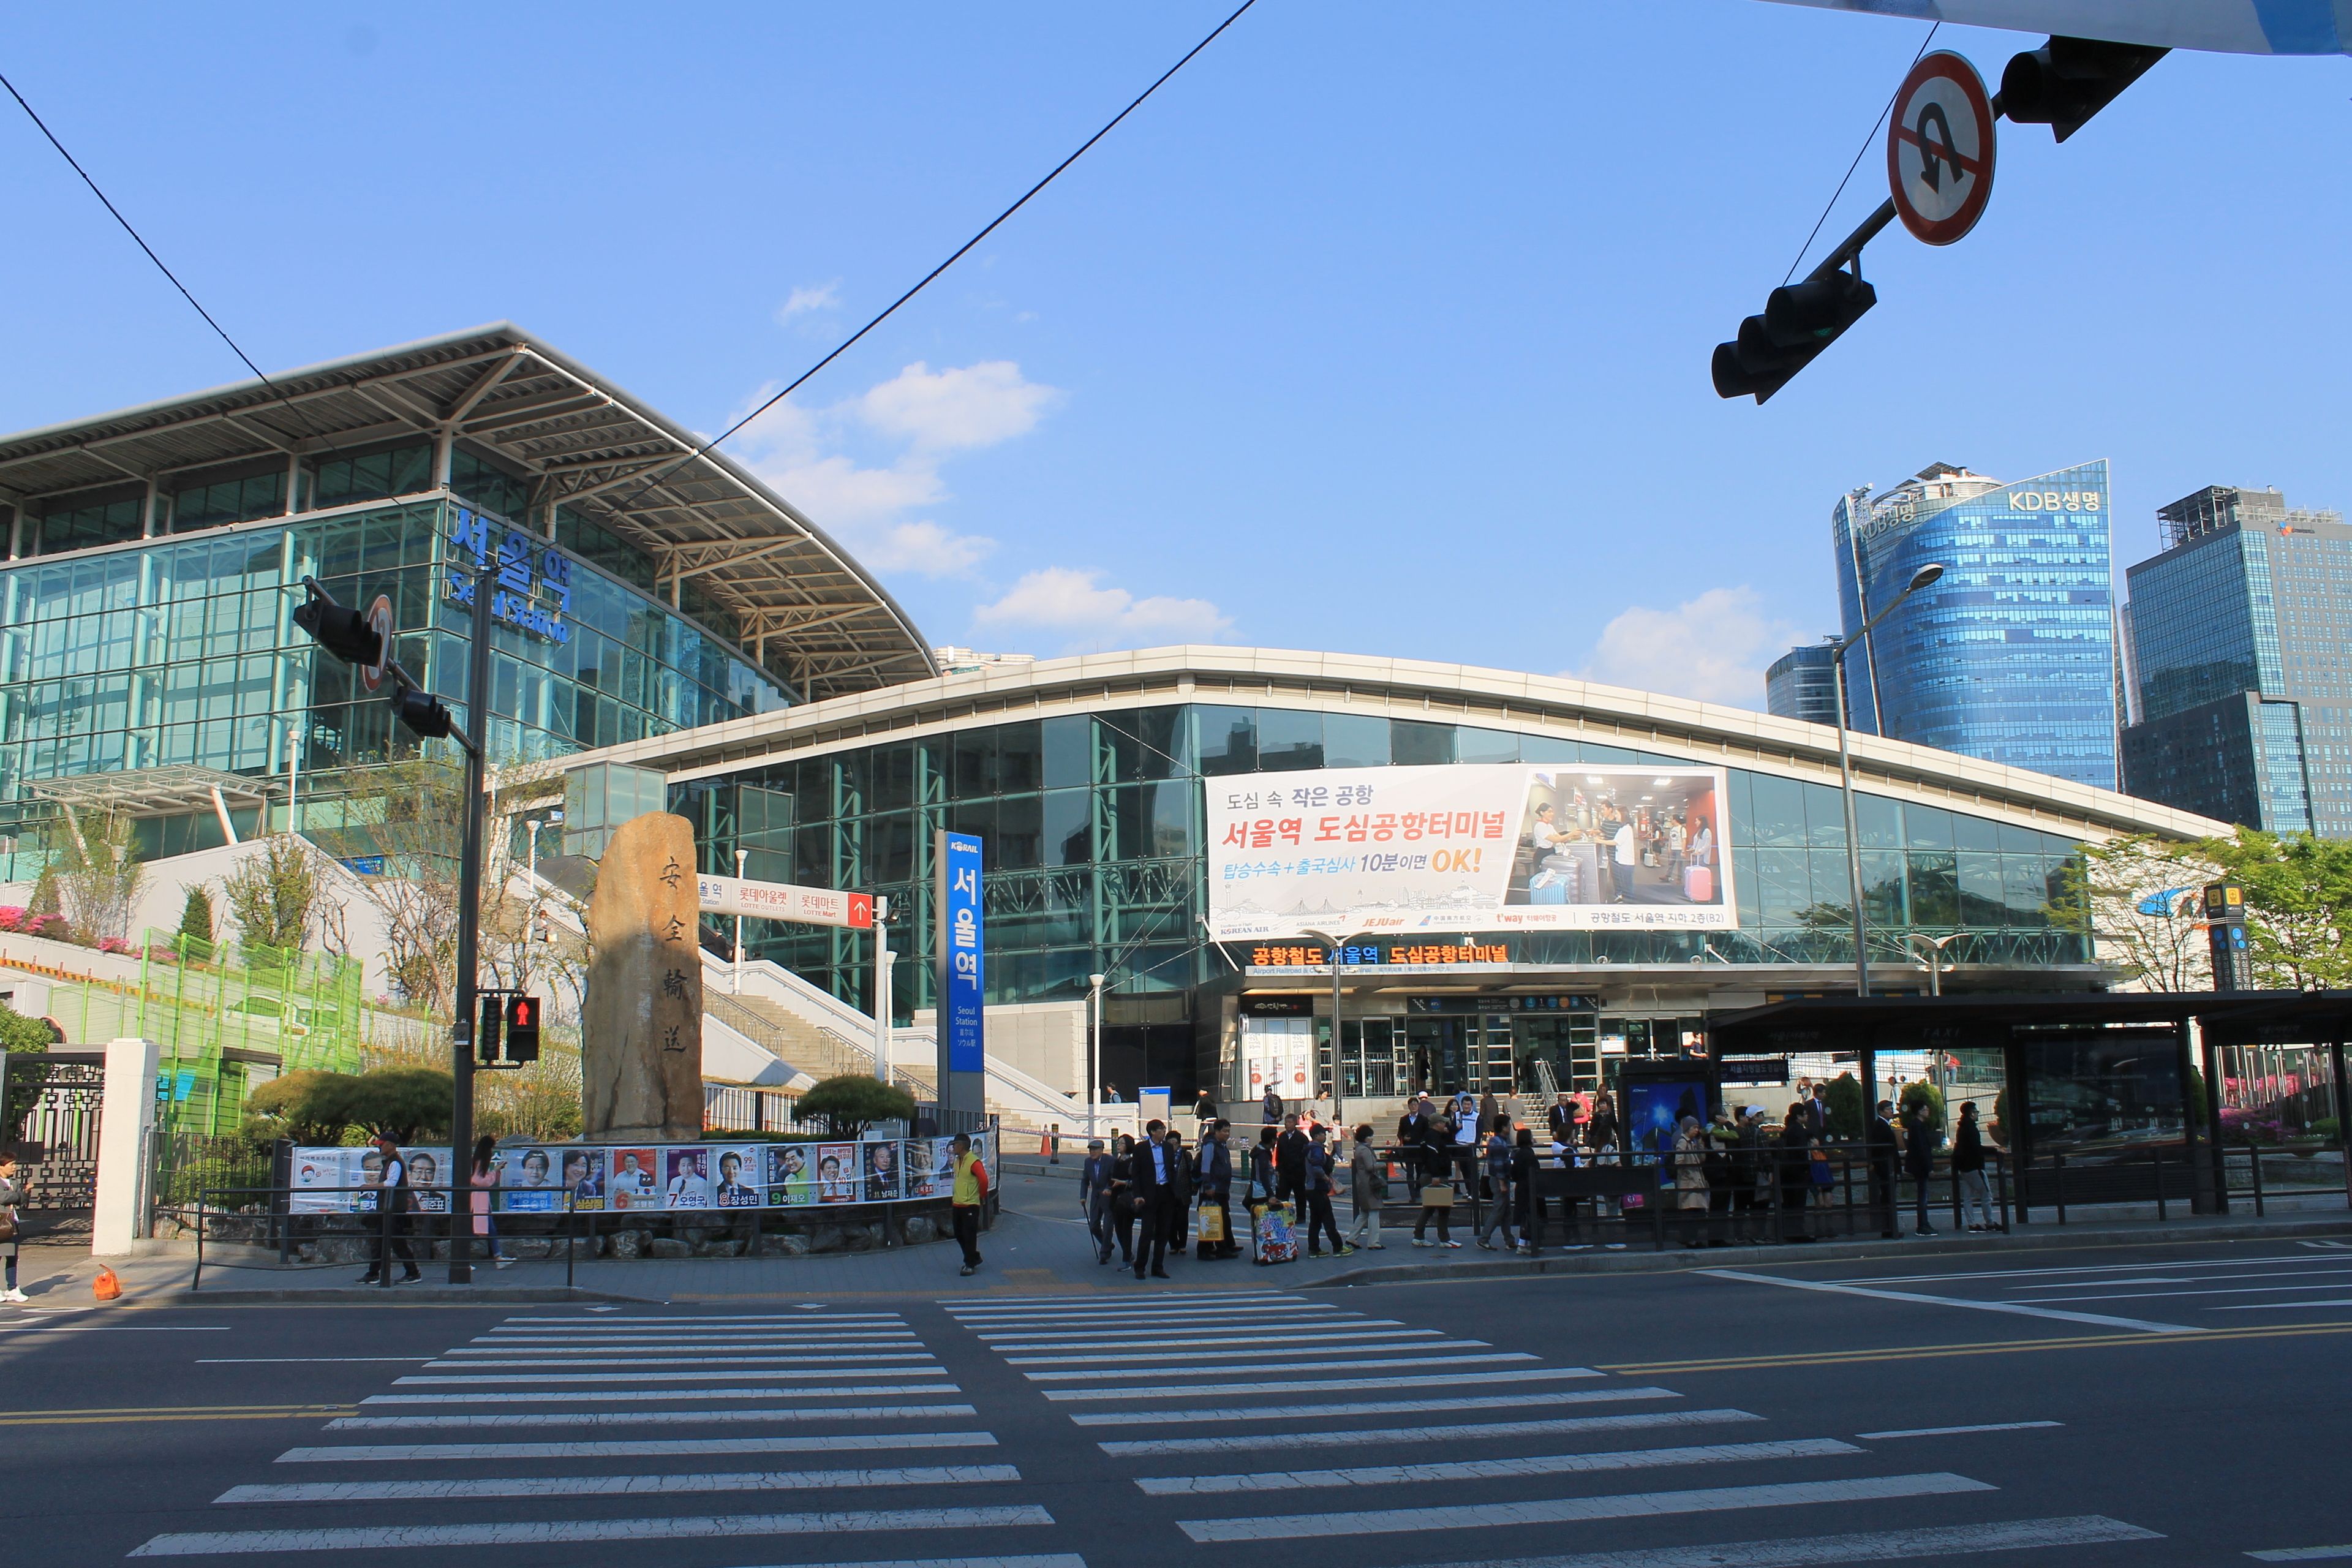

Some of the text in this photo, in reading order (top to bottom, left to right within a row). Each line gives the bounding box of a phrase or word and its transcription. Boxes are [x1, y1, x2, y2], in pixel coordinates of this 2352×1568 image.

[2008, 491, 2099, 511] KDB생명
[451, 508, 571, 614] 서울역
[507, 596, 569, 644] Station
[1227, 784, 1373, 810] 도심 속 작은 공항
[1222, 810, 1506, 849] 서울역 도심공항터미널
[951, 841, 979, 854] KORAIL
[1361, 853, 1428, 873] 10분이면
[1432, 847, 1482, 873] OK!
[702, 897, 720, 905] Station
[739, 887, 787, 905] 롯데아울렛
[801, 894, 840, 910] 롯데마트
[1590, 912, 1725, 924] 공항철도 서울역 지하 2층(B2)
[953, 866, 978, 992] 서울역
[1220, 927, 1253, 935] KOREAN
[1253, 944, 1509, 966] 공항철도 서울역 도심공항터미널
[957, 1006, 976, 1015] Seoul
[956, 1017, 978, 1026] Station
[939, 1147, 946, 1157] 13
[669, 1193, 678, 1207] 7
[719, 1192, 730, 1207] 8
[731, 1194, 758, 1205] 장성민
[771, 1192, 782, 1204] 9
[782, 1194, 805, 1204] 이재오
[881, 1189, 899, 1198] 남재준
[421, 1200, 445, 1210] 홍준표
[576, 1199, 603, 1210] 심상정
[616, 1193, 629, 1210] 6
[680, 1196, 706, 1207] 오영국
